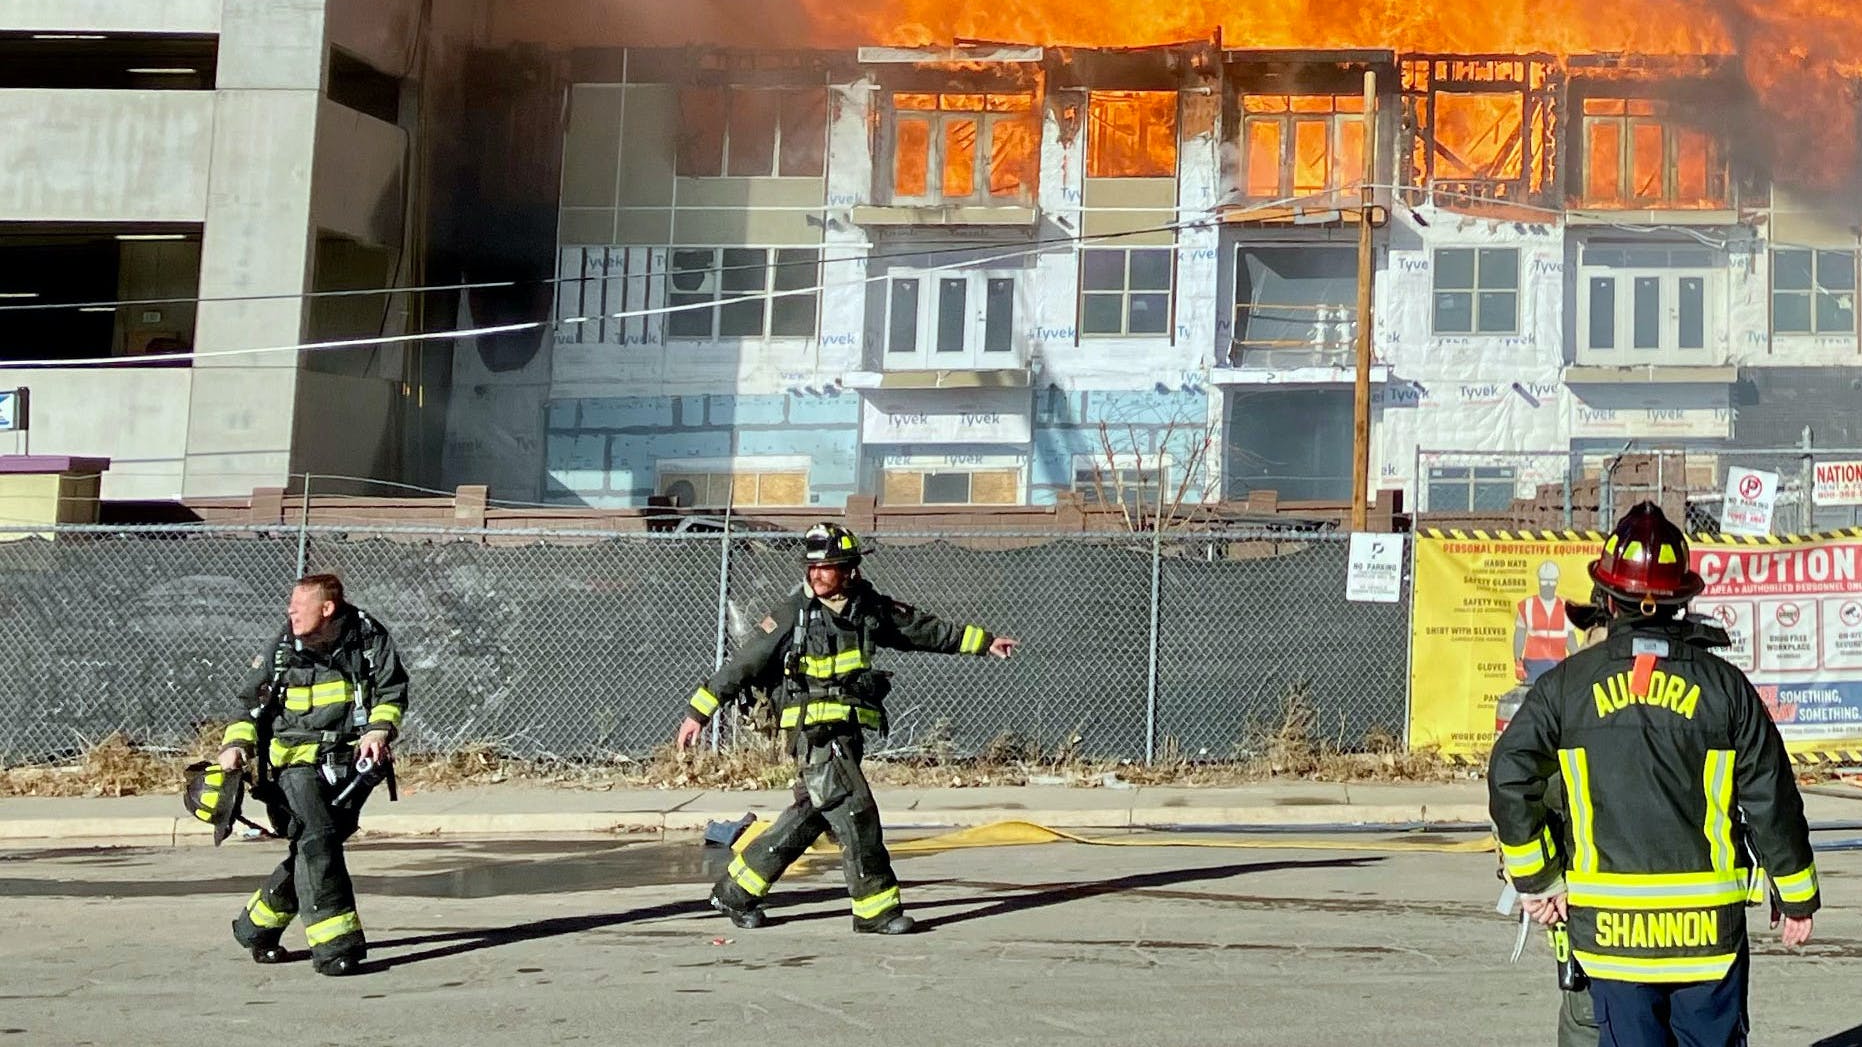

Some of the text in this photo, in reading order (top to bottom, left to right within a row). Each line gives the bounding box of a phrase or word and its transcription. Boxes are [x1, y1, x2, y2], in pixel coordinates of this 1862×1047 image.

[1398, 258, 1429, 272] Tyve
[821, 333, 855, 345] yvek
[1459, 385, 1498, 398] Tyvek
[888, 411, 1000, 428] Tyvek Tyvek
[1645, 408, 1684, 423] Tyvek
[1553, 544, 1602, 556] EQUIPMEN
[1700, 548, 1856, 585] CAUTION
[1780, 688, 1842, 704] SOMETHING,
[1798, 706, 1862, 722] SOMETHING.
[1595, 910, 1718, 948] SHANNON
